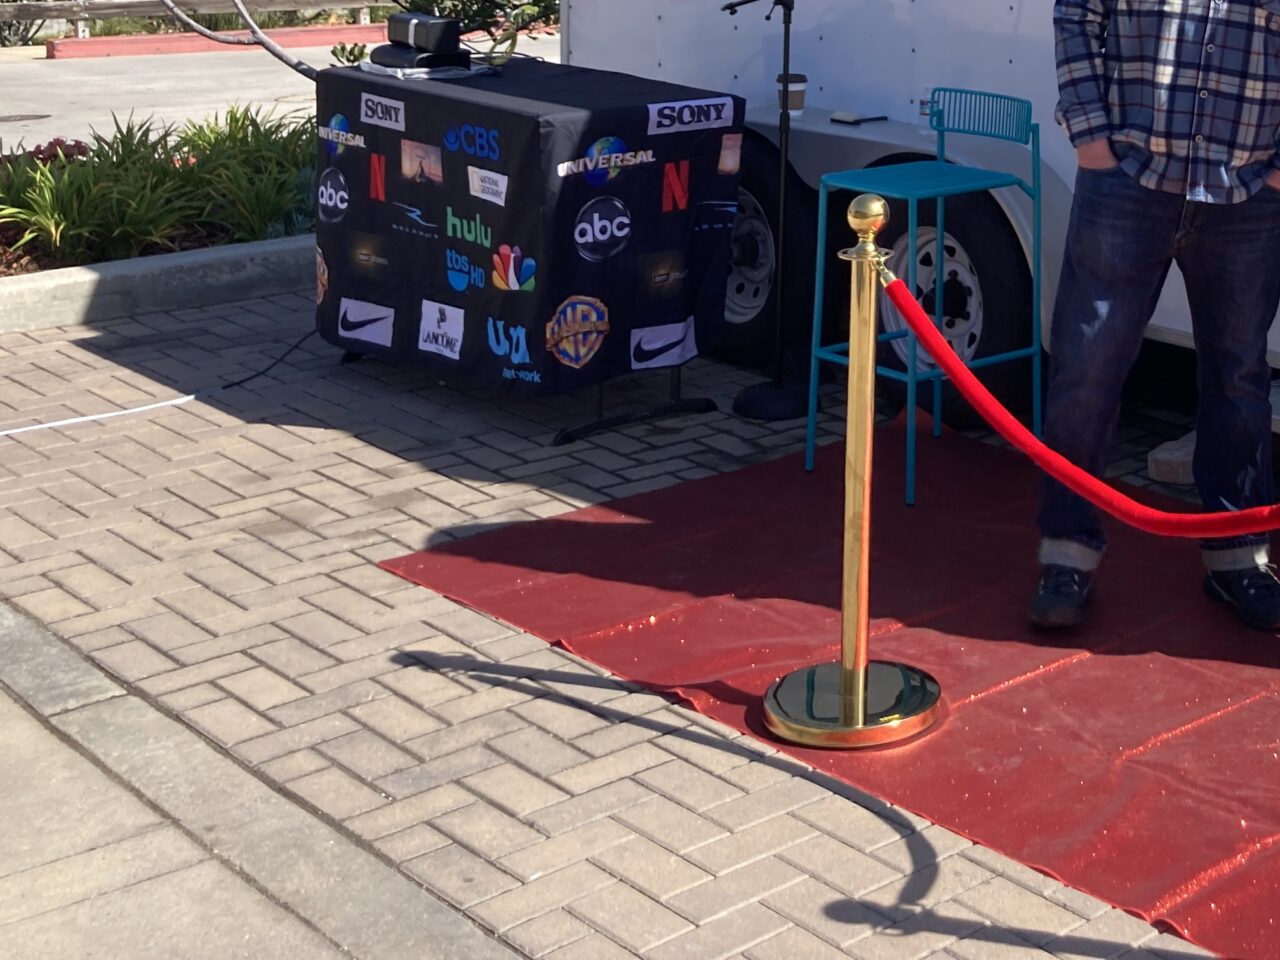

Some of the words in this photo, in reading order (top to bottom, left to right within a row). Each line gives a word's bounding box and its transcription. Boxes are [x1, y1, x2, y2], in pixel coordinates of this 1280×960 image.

[364, 98, 401, 123] SONY
[656, 102, 727, 129] SONY
[460, 123, 501, 160] CBS
[557, 150, 656, 177] UNIVERSAL
[318, 180, 349, 209] abc
[662, 160, 690, 213] N
[446, 206, 491, 248] hulu
[574, 212, 631, 244] abc
[445, 248, 470, 273] tbs
[470, 264, 486, 289] HD
